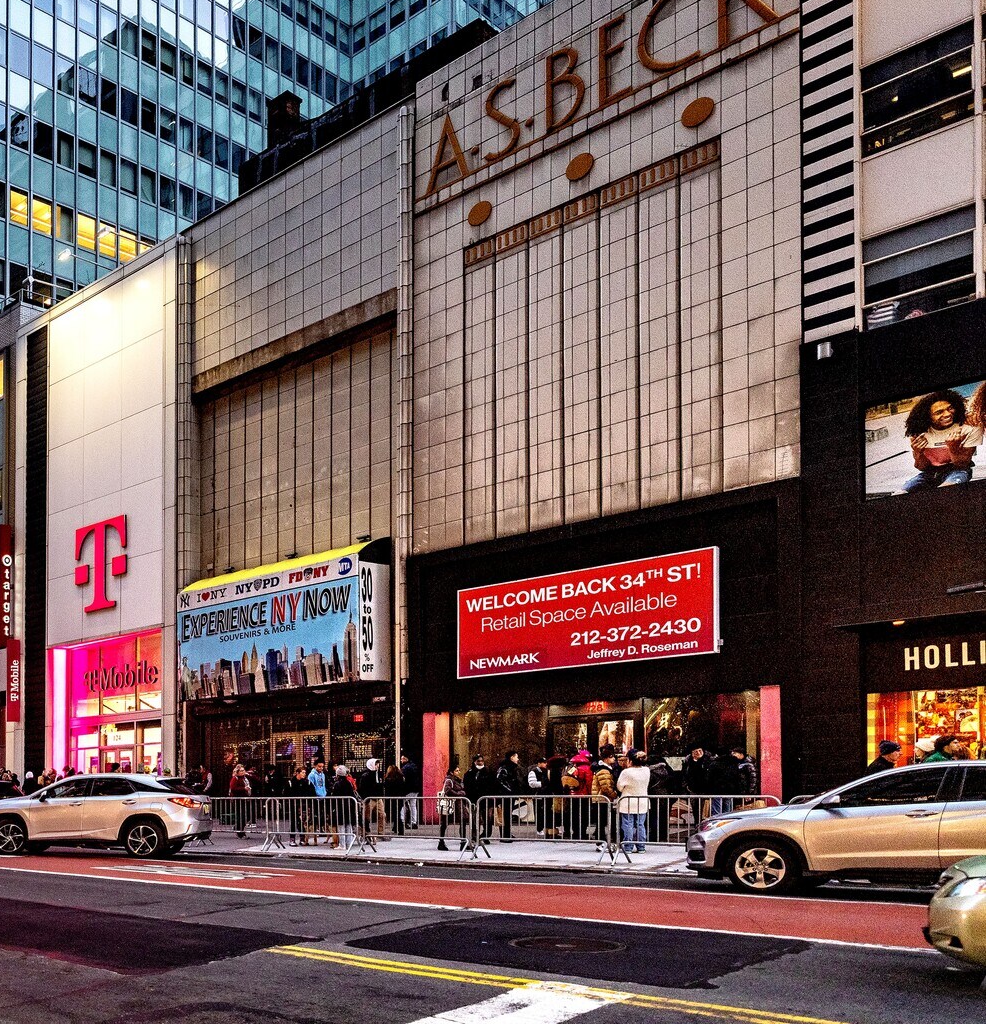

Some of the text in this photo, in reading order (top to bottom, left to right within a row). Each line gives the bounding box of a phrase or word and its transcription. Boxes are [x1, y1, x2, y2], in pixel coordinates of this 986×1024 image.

[74, 514, 128, 613] T
[338, 561, 351, 573] MTA
[361, 566, 373, 603] 30
[466, 585, 558, 613] WELCOME
[561, 576, 616, 599] BACK
[667, 562, 701, 583] ST!
[2, 569, 11, 636] target
[181, 583, 351, 643] EXPERIENCE NY NOW
[363, 606, 372, 614] to
[481, 591, 678, 633] Retail Space Available
[219, 623, 296, 643] SOUVENIRS & MORE
[362, 615, 373, 651] 50
[570, 617, 702, 647] 212-372-2430
[364, 653, 371, 662] %
[469, 651, 540, 670] NEWMARK
[587, 640, 699, 660] Jeffrey D. Roseman
[361, 663, 374, 673] OFF
